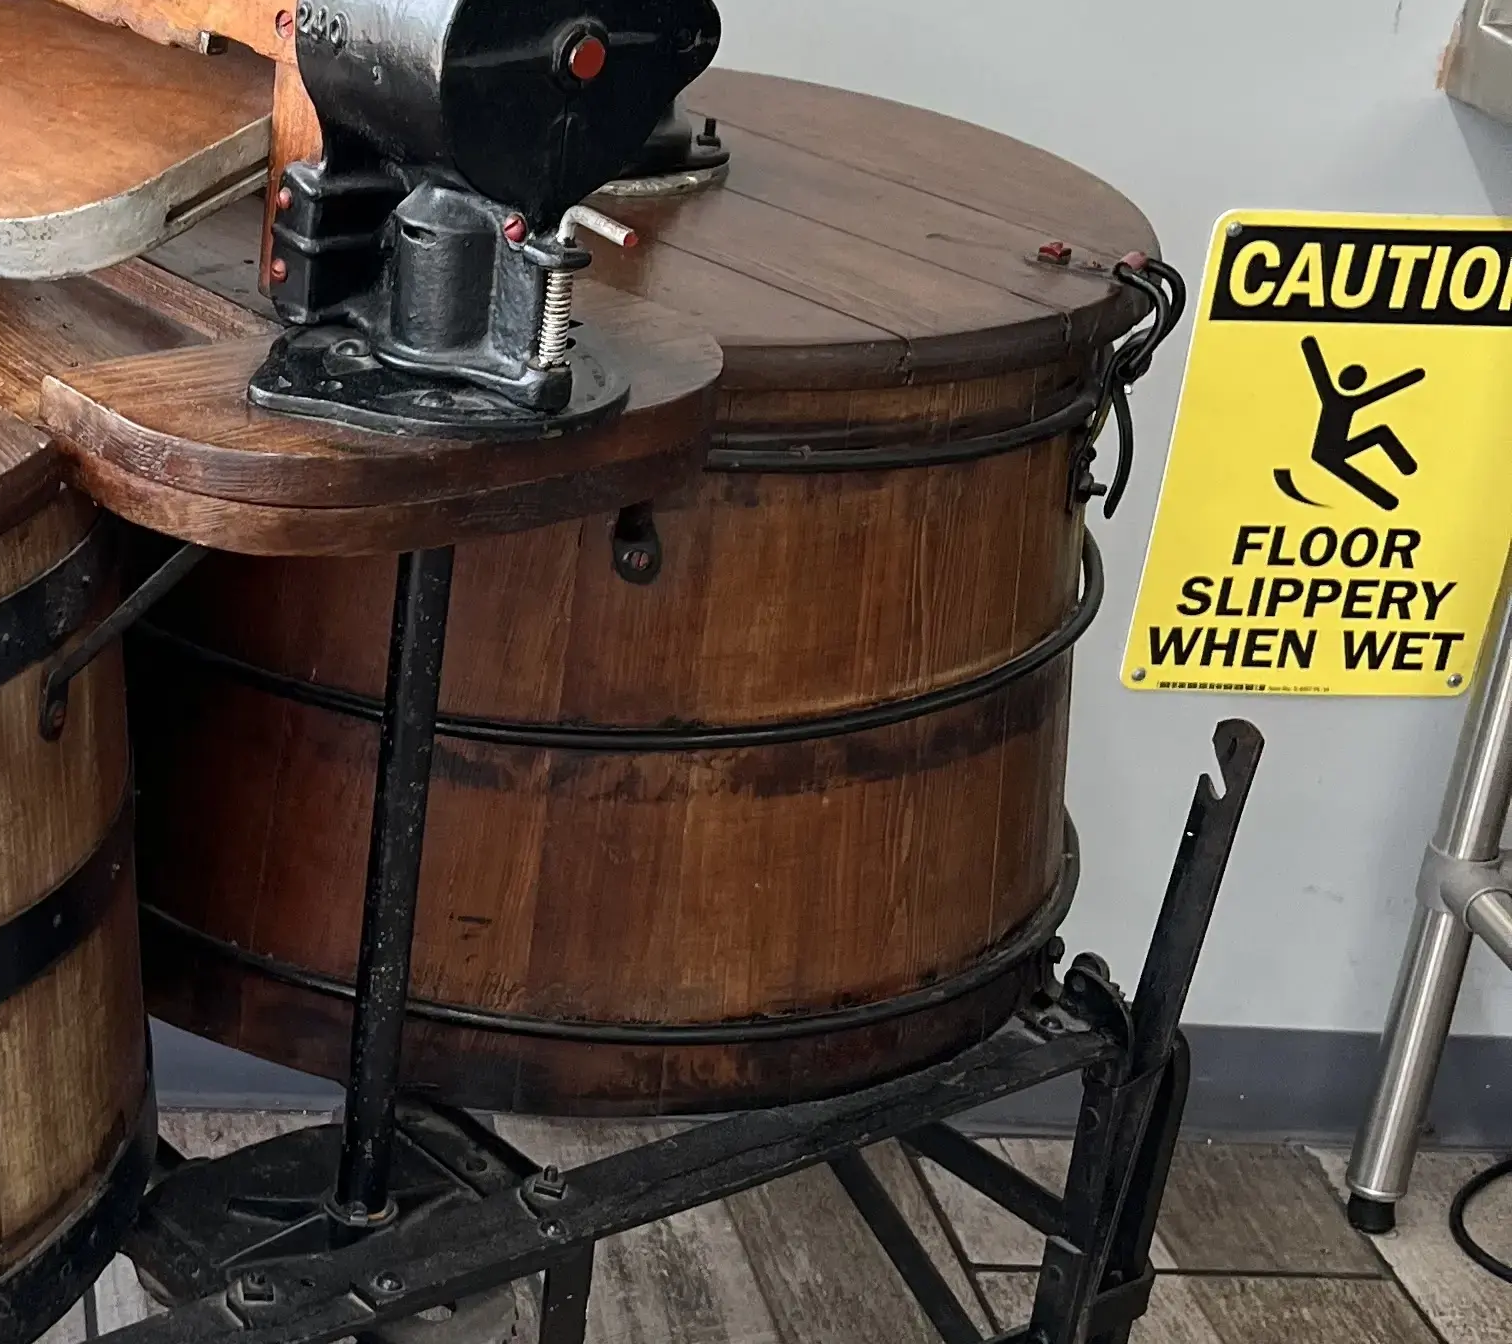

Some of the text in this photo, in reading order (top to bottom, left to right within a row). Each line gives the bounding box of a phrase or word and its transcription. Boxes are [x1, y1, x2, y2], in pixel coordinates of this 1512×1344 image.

[1228, 239, 1512, 312] CAUTIO
[1231, 525, 1421, 569] FLOOR
[1176, 575, 1457, 621] SLIPPERY
[1149, 626, 1465, 671] WHEN WET
